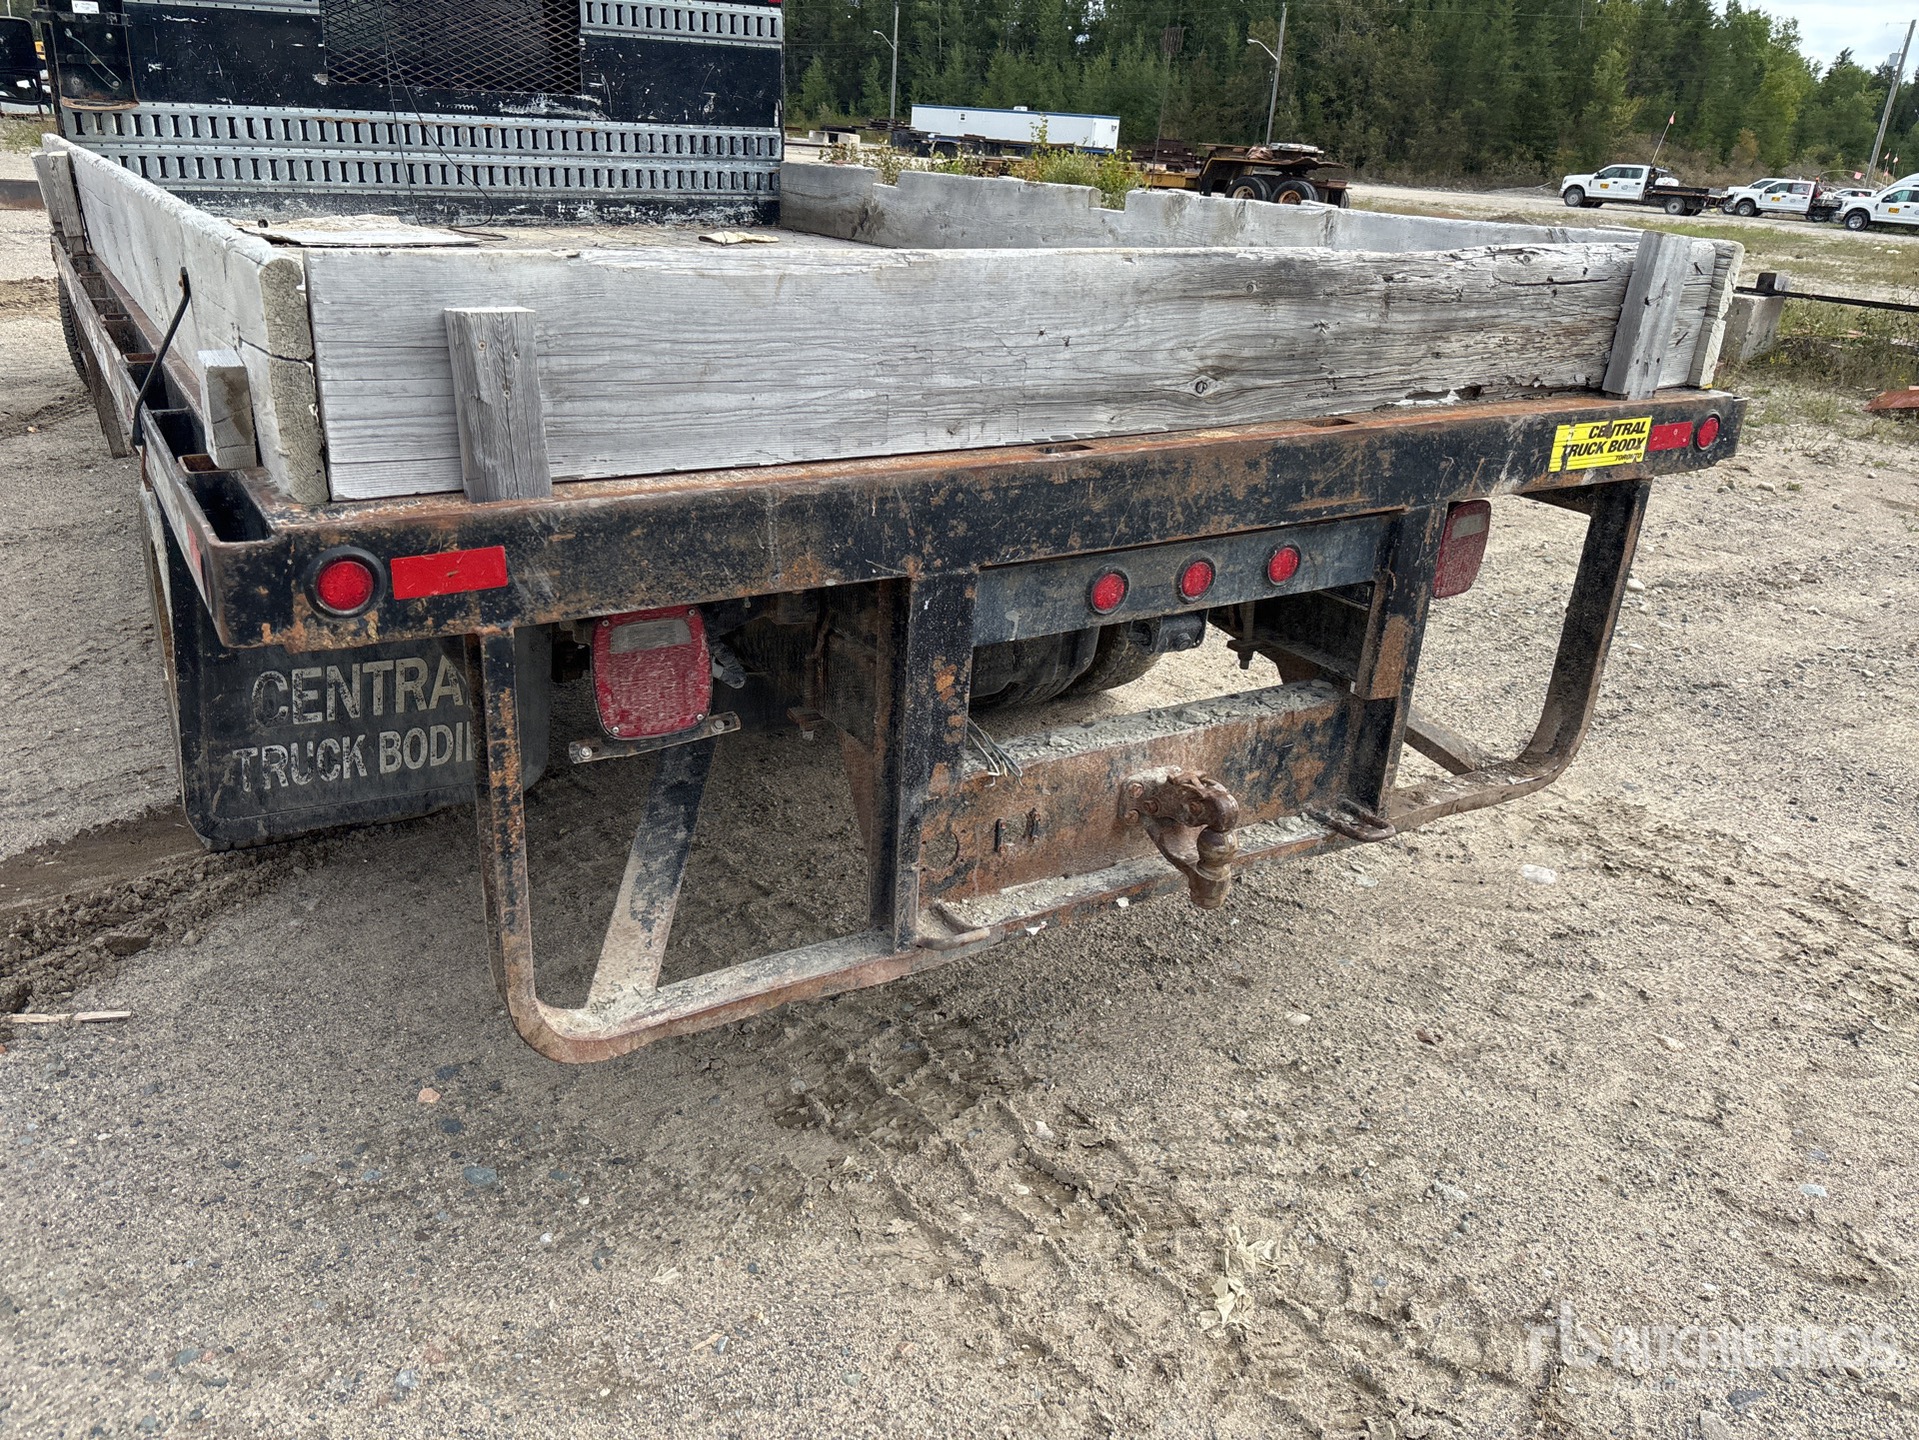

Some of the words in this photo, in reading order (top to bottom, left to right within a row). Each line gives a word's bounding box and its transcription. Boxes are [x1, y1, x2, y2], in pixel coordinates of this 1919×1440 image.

[1562, 441, 1608, 457] TRUCK
[1607, 437, 1646, 453] BODY
[252, 655, 469, 728] CENTRA
[232, 734, 368, 792] TRUCK
